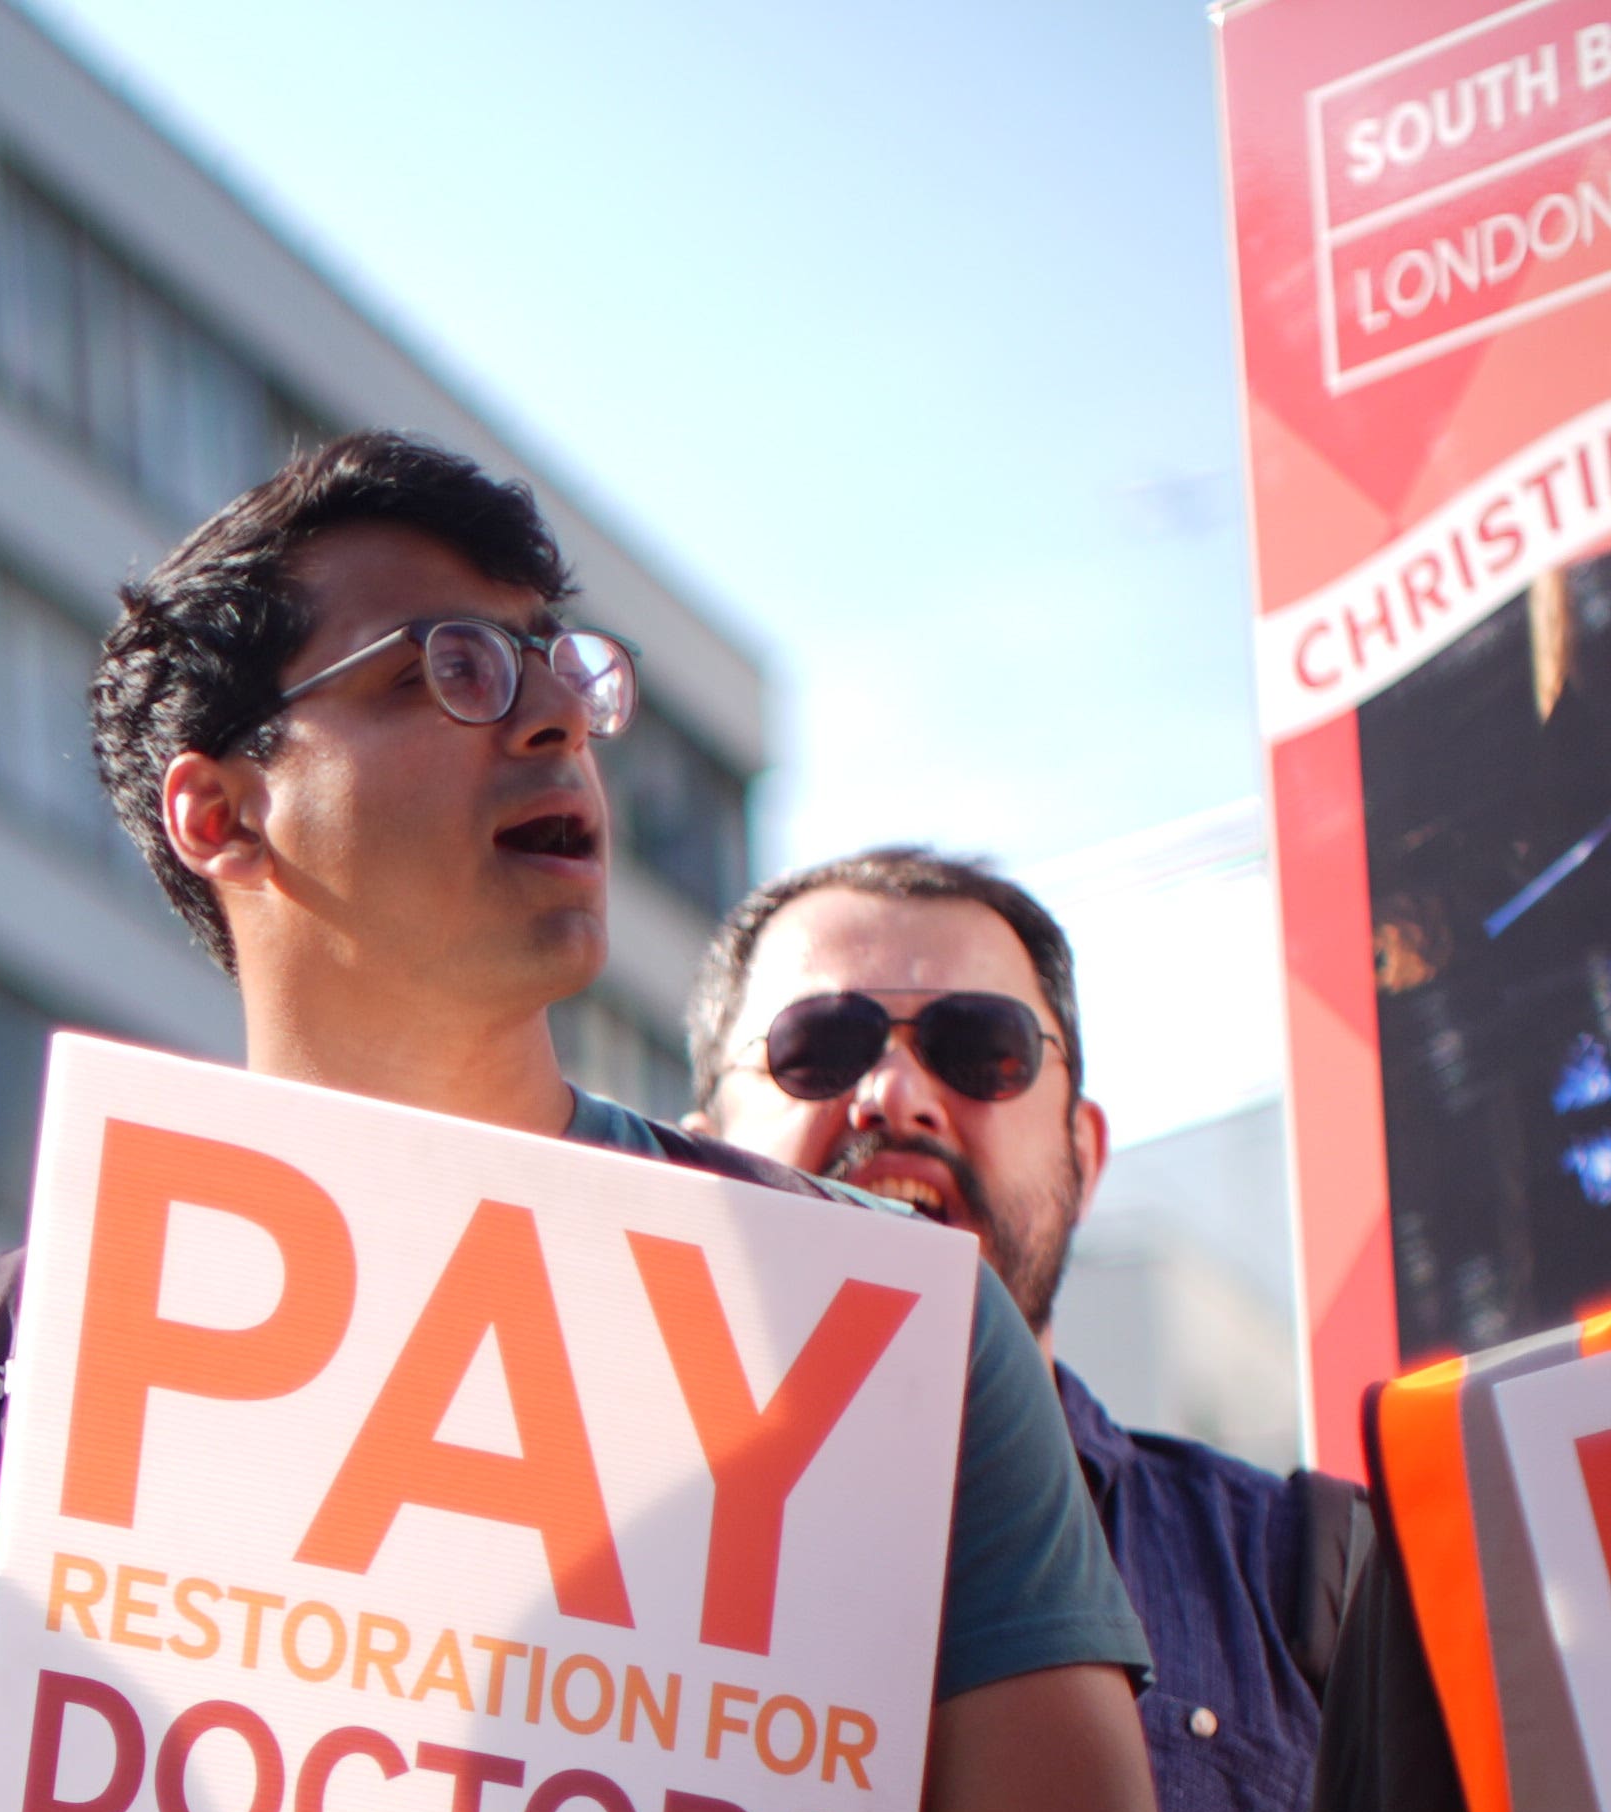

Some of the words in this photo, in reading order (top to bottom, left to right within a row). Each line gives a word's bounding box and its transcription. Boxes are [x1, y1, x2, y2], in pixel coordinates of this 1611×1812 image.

[1345, 42, 1559, 185] SOUTH
[1291, 428, 1611, 692] CHRISTI
[59, 1117, 922, 1656] PAY
[44, 1551, 682, 1753] RESTORATION
[703, 1682, 879, 1792] FOR
